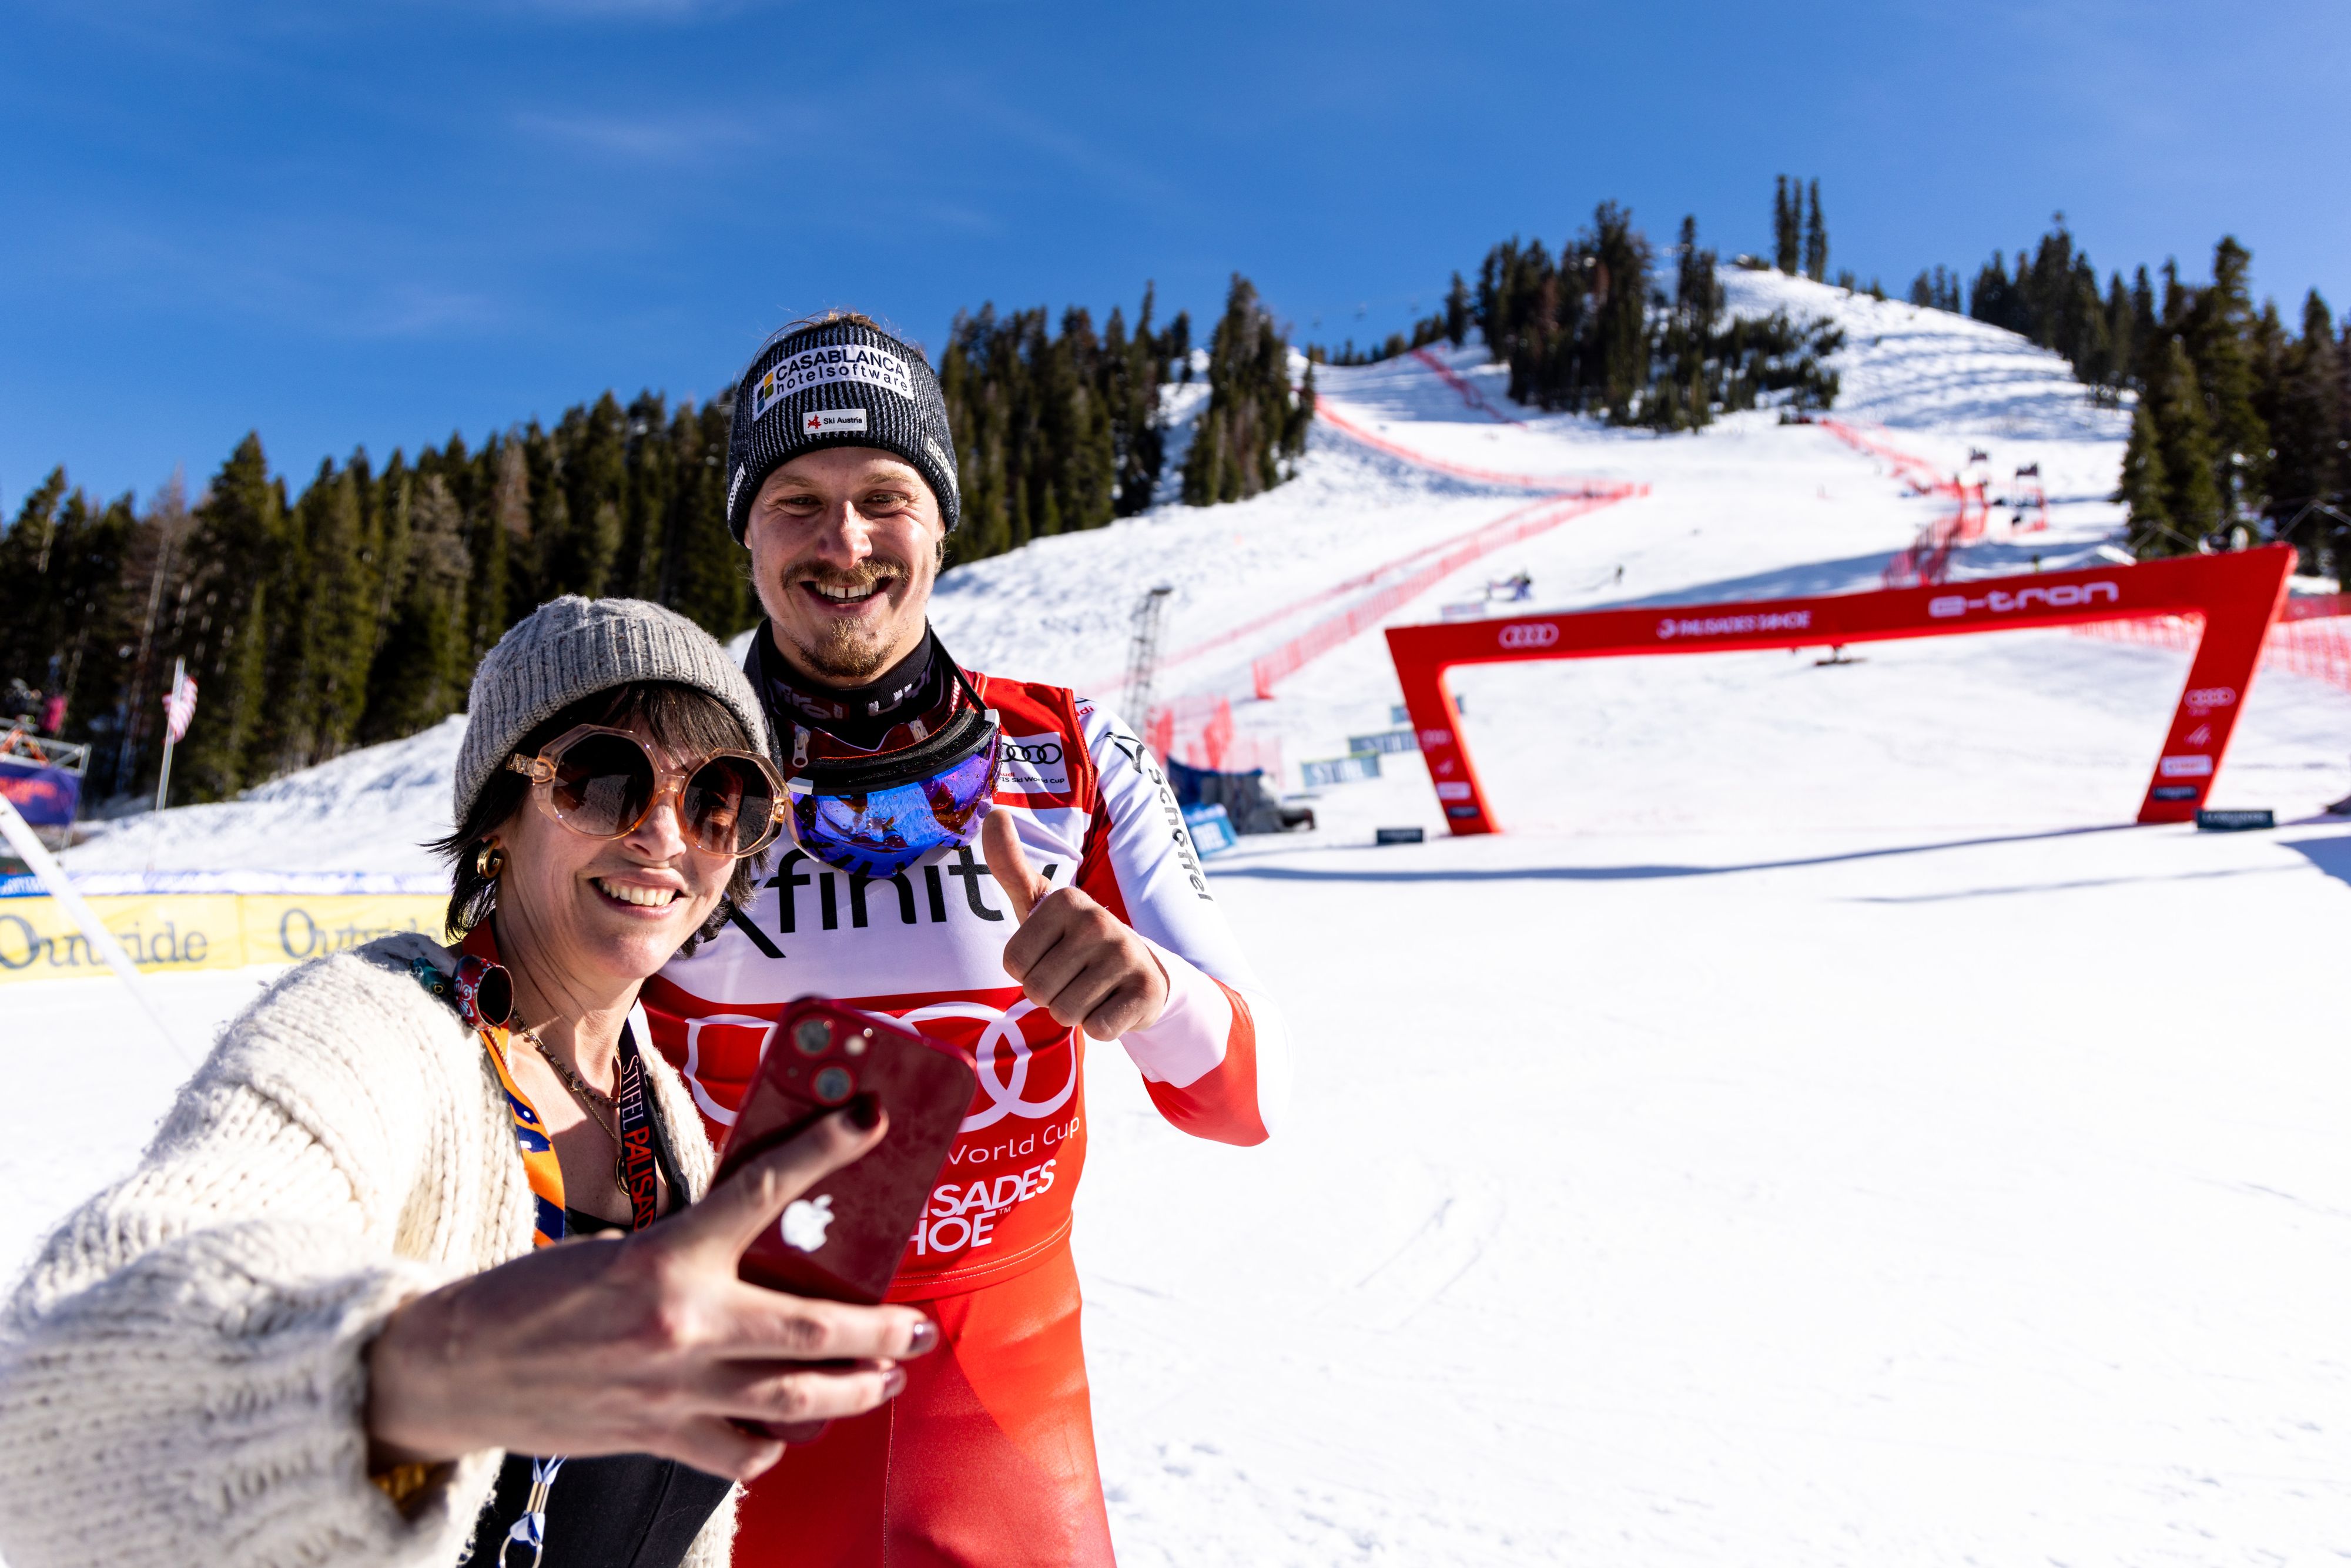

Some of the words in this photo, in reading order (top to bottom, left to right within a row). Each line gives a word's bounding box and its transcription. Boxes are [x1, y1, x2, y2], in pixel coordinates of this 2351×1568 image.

[776, 349, 906, 381] CASABLANCA
[776, 363, 907, 394] hotelsoftware
[1928, 581, 2119, 618] e-tron
[622, 1054, 644, 1131] STIFEL
[1043, 1117, 1080, 1145] Cup
